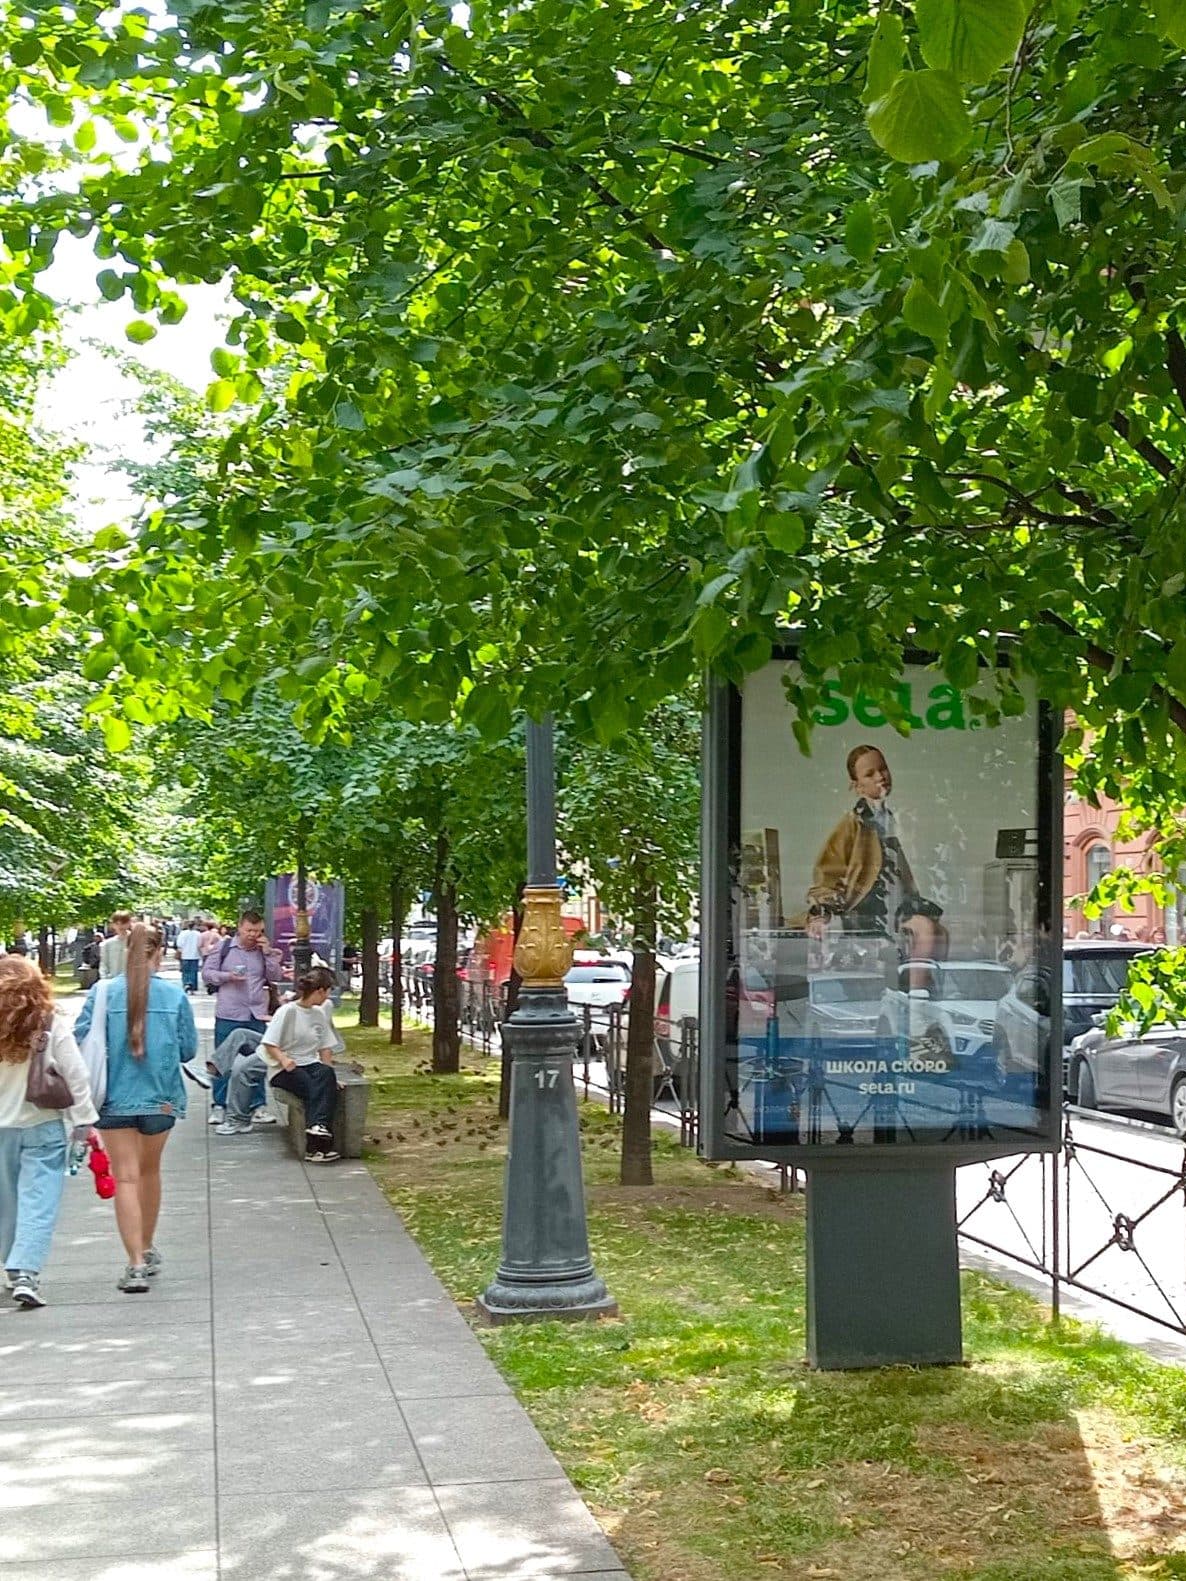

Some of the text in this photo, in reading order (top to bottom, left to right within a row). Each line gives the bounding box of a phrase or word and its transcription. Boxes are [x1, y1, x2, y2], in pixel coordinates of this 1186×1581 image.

[826, 1060, 947, 1073] ШКОЛА СКОРО
[534, 1069, 559, 1088] 17
[858, 1082, 915, 1094] sela.ru
